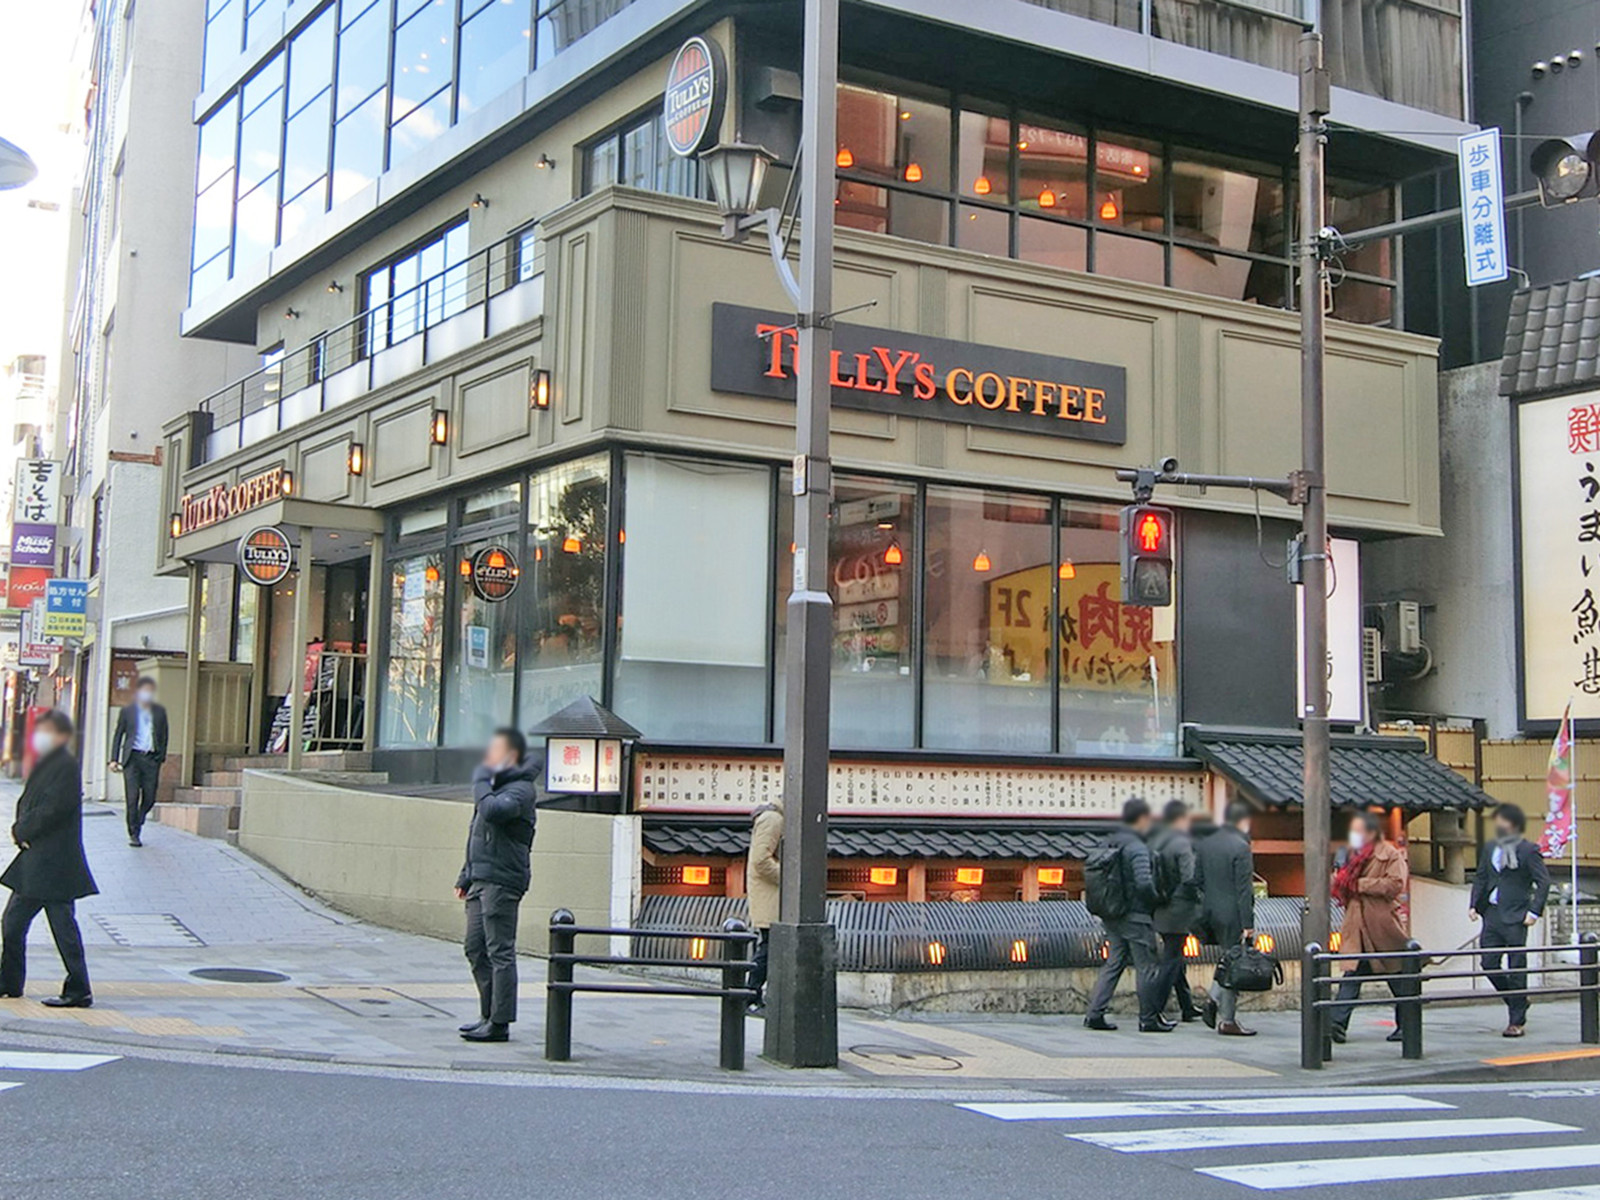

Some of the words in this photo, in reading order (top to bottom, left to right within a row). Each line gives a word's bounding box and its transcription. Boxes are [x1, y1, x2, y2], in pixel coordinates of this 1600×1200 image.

[1469, 144, 1496, 272] 歩車分離式
[756, 323, 937, 401] TLLY'S
[945, 367, 1107, 424] COFFEE
[24, 461, 54, 521] 吉そば
[228, 466, 283, 515] COFFEE
[14, 545, 50, 555] School
[18, 535, 54, 546] Music
